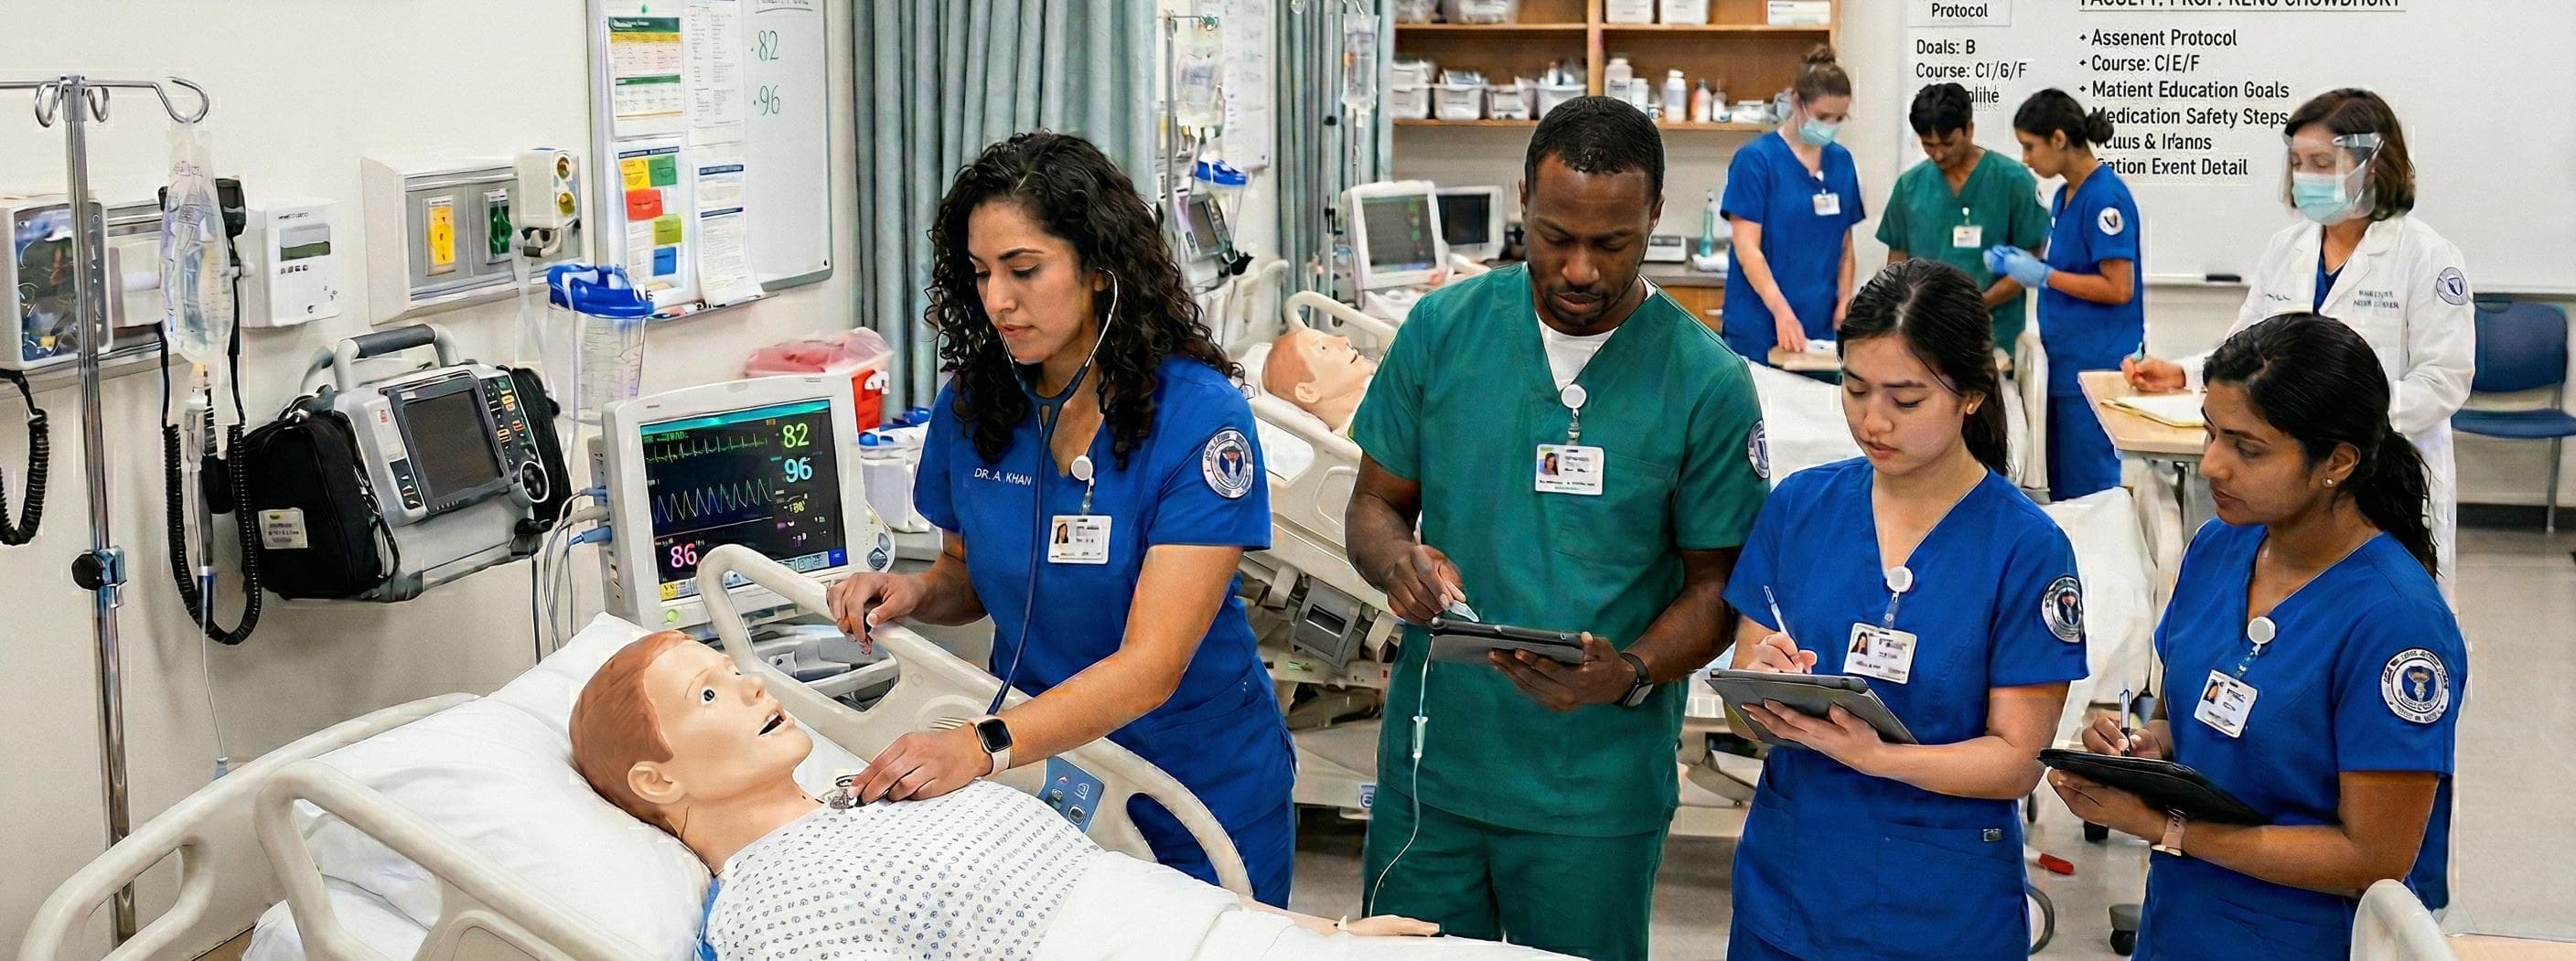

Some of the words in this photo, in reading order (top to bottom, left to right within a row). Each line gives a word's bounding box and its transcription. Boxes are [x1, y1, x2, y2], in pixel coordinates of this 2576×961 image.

[1932, 3, 1989, 17] Protocol
[758, 30, 778, 61] 82
[2092, 28, 2165, 46] Assenent
[2172, 28, 2238, 46] Protocol
[1916, 39, 1959, 54] Doals:
[1966, 39, 1976, 54] B
[1916, 62, 1970, 78] Course:
[2092, 54, 2151, 71] Course:
[2092, 80, 2153, 98] Matient
[2159, 80, 2238, 98] Education
[2244, 80, 2290, 98] Goals
[760, 85, 779, 115] 96
[2092, 107, 2180, 124] edication
[2186, 107, 2238, 129] Safety
[2243, 107, 2288, 129] Steps
[2152, 158, 2196, 175] Exent
[2202, 158, 2249, 175] Detail
[782, 422, 810, 449] 82
[785, 455, 812, 484] 96
[1006, 472, 1032, 486] KHAN
[671, 543, 698, 569] 86
